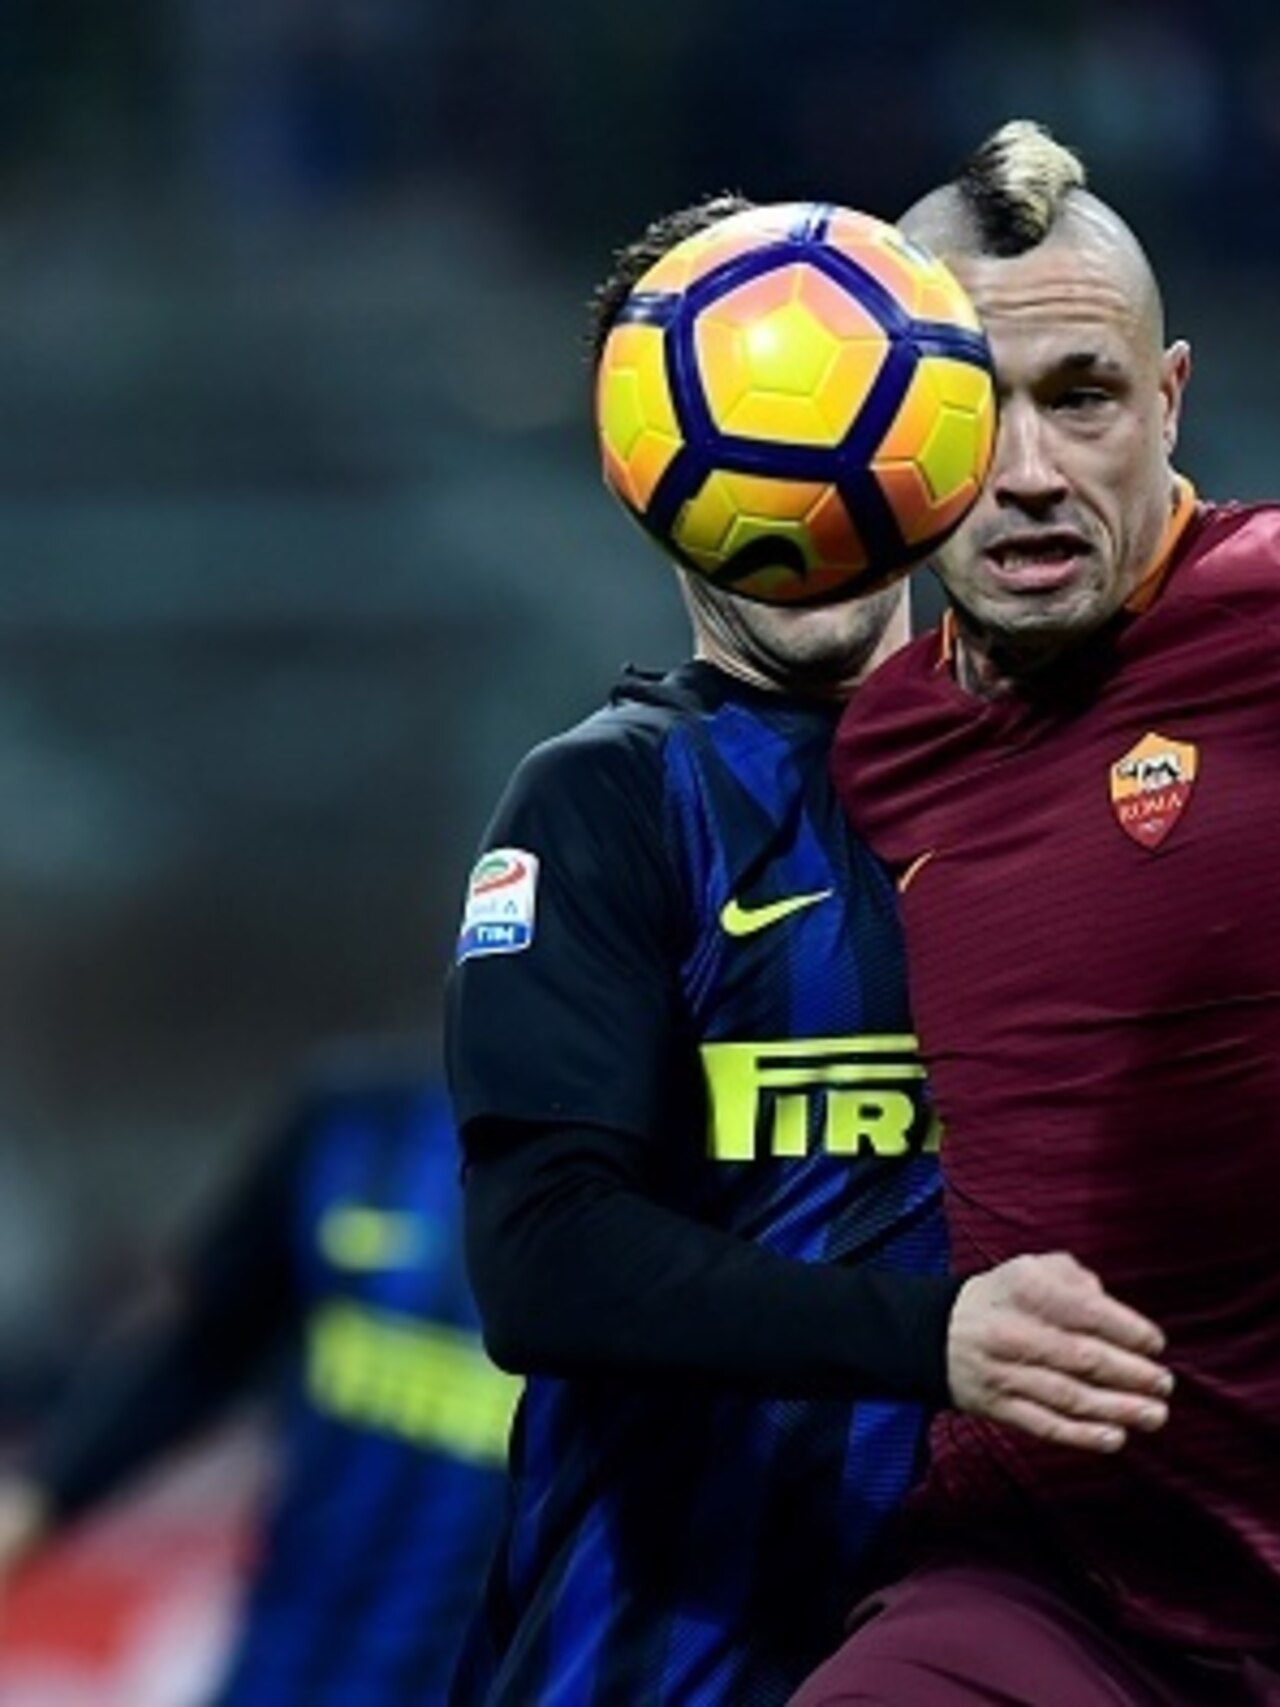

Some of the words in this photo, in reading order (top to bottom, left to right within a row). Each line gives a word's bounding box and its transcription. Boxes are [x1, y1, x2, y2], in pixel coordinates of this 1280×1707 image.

[1120, 792, 1183, 822] ROMA
[475, 924, 515, 945] TIM
[699, 1033, 944, 1161] PIR
